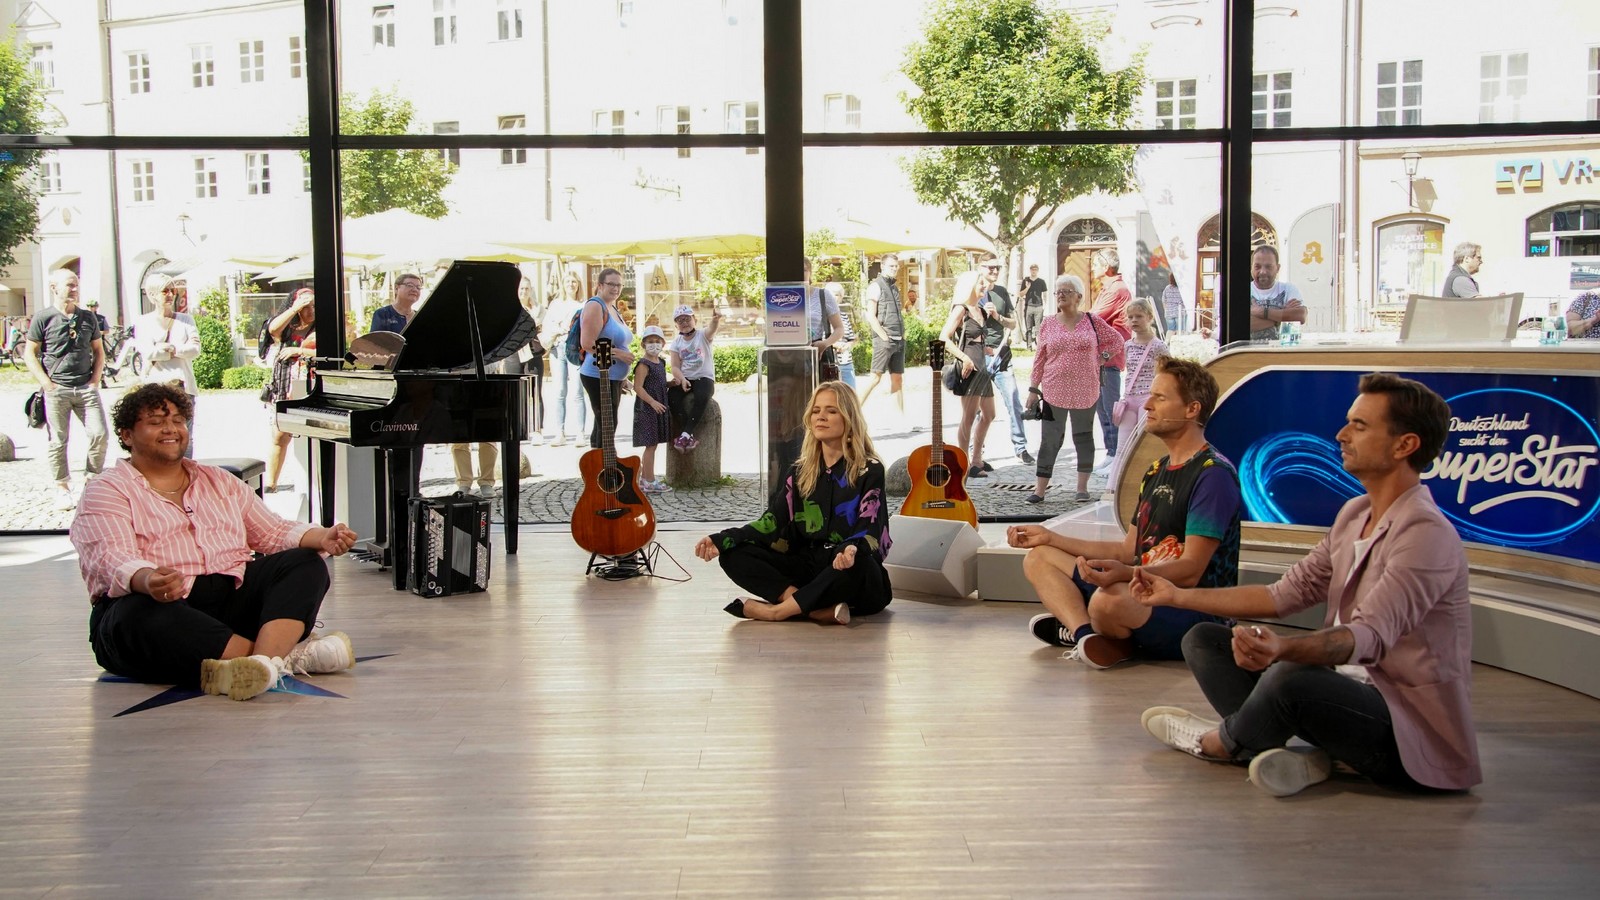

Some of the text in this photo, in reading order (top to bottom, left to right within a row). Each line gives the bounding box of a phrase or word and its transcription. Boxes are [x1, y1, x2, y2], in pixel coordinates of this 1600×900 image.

[1449, 413, 1530, 431] Deutschland
[1459, 433, 1510, 446] sucht den
